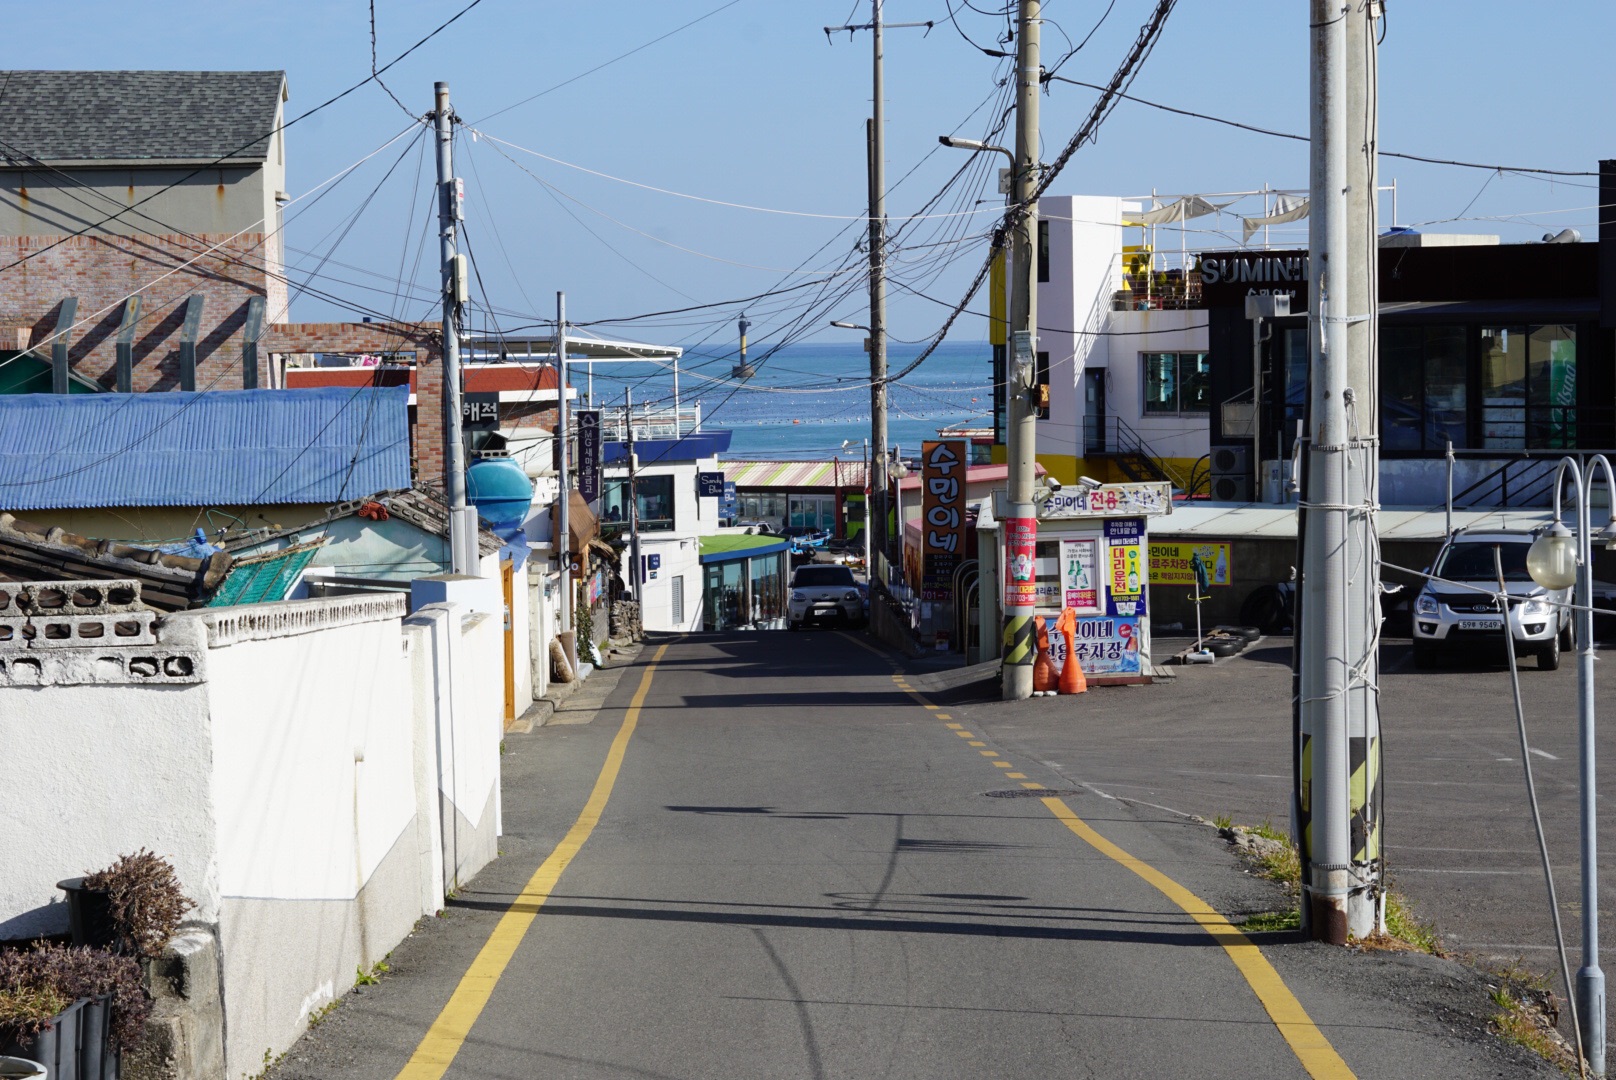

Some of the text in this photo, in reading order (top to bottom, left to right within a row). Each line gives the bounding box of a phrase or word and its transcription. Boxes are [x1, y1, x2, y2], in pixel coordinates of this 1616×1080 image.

[463, 402, 498, 421] 해적
[701, 475, 722, 485] Sandy
[928, 443, 960, 552] 수민이네
[1043, 496, 1087, 512] 수민이네
[1147, 546, 1179, 557] 민이네
[1113, 547, 1126, 593] 대리운전
